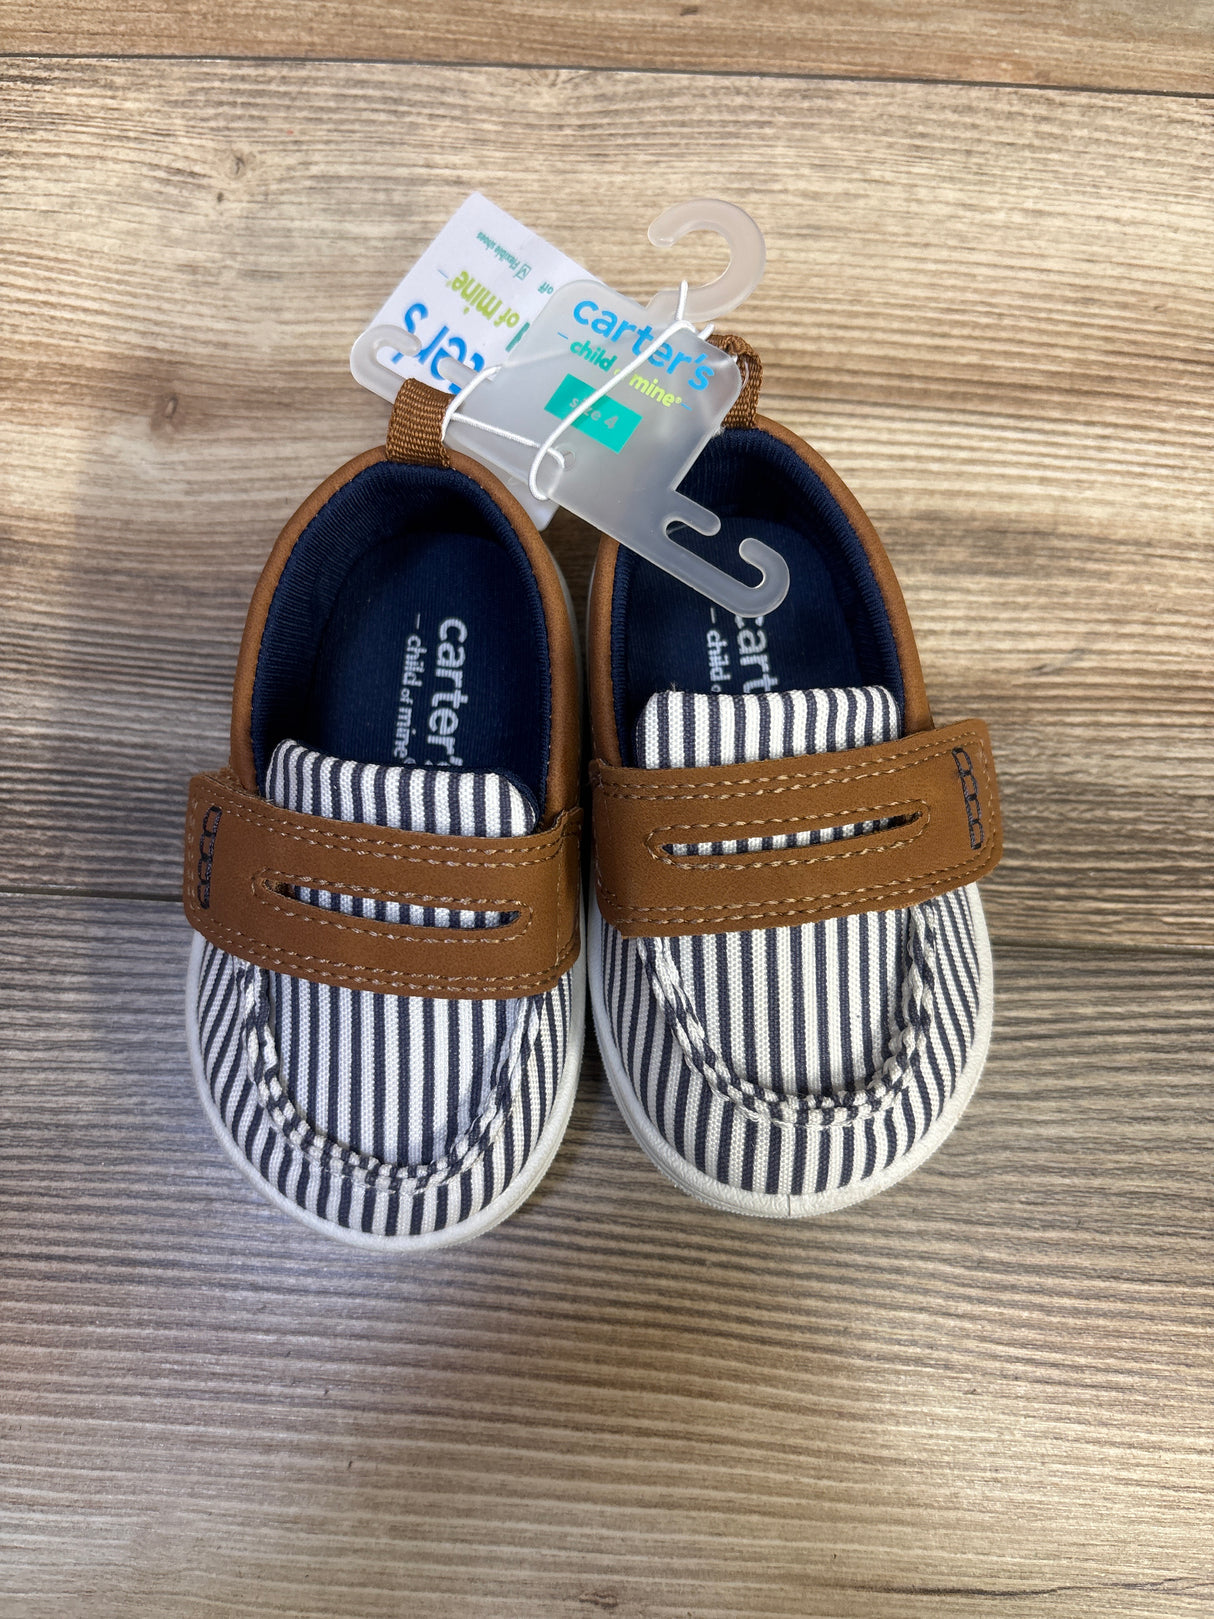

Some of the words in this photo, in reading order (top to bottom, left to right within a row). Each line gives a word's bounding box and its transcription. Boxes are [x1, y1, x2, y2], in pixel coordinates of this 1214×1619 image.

[476, 231, 496, 250] shoes
[494, 245, 521, 271] Flexible
[451, 270, 504, 321] mine
[538, 281, 555, 295] off
[493, 307, 521, 329] of
[569, 340, 618, 373] child
[573, 300, 715, 391] carter's
[569, 397, 602, 421] sze
[604, 415, 619, 429] 4
[402, 635, 428, 687] child
[706, 630, 732, 682] child
[400, 688, 414, 705] of
